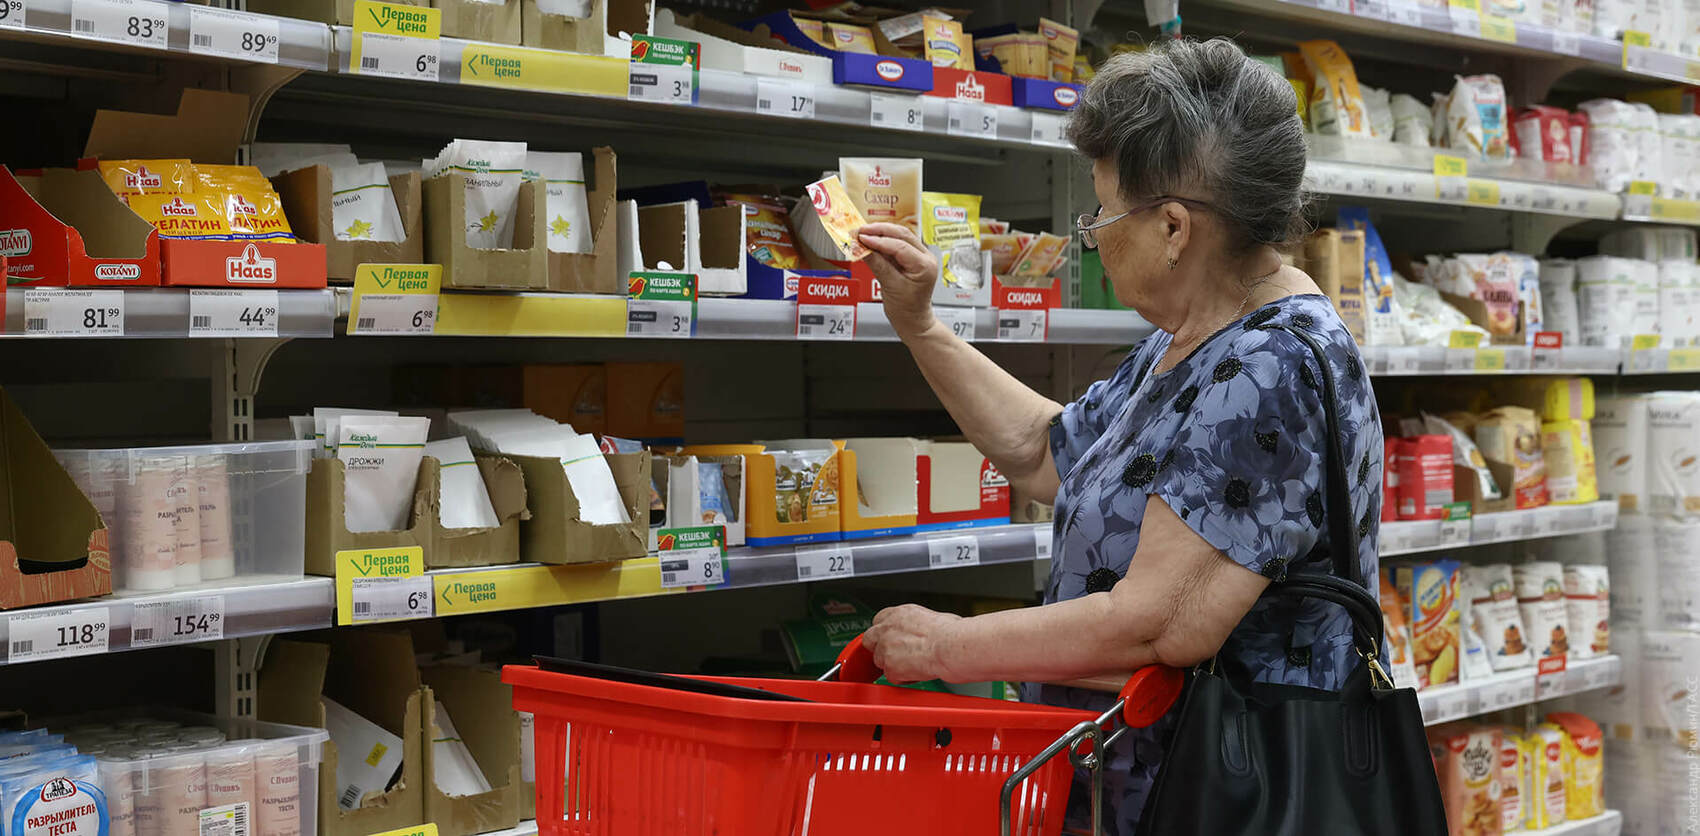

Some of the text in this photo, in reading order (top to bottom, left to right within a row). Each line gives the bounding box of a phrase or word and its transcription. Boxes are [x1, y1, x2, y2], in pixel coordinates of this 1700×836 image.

[382, 6, 427, 23] Первая
[397, 22, 426, 33] цена
[481, 54, 521, 69] Первая
[494, 67, 521, 78] цена
[957, 86, 982, 99] Haas
[868, 176, 889, 186] Haas
[864, 190, 899, 208] Сахар
[163, 205, 195, 216] Haas
[230, 262, 273, 280] Haas
[384, 268, 429, 281] Первая
[398, 280, 427, 291] цена
[650, 278, 681, 287] КЕШБЭК
[807, 283, 849, 298] СКИДКА
[1007, 292, 1043, 305] СКИДКА
[348, 457, 384, 466] ДРОЖЖИ
[363, 554, 409, 566] Первая
[380, 565, 410, 577] цена
[454, 582, 496, 595] Первая
[469, 591, 496, 603] цена
[27, 803, 97, 829] РАЗРЫХЛИТЕЛЬ
[48, 820, 77, 836] ТЕСТА
